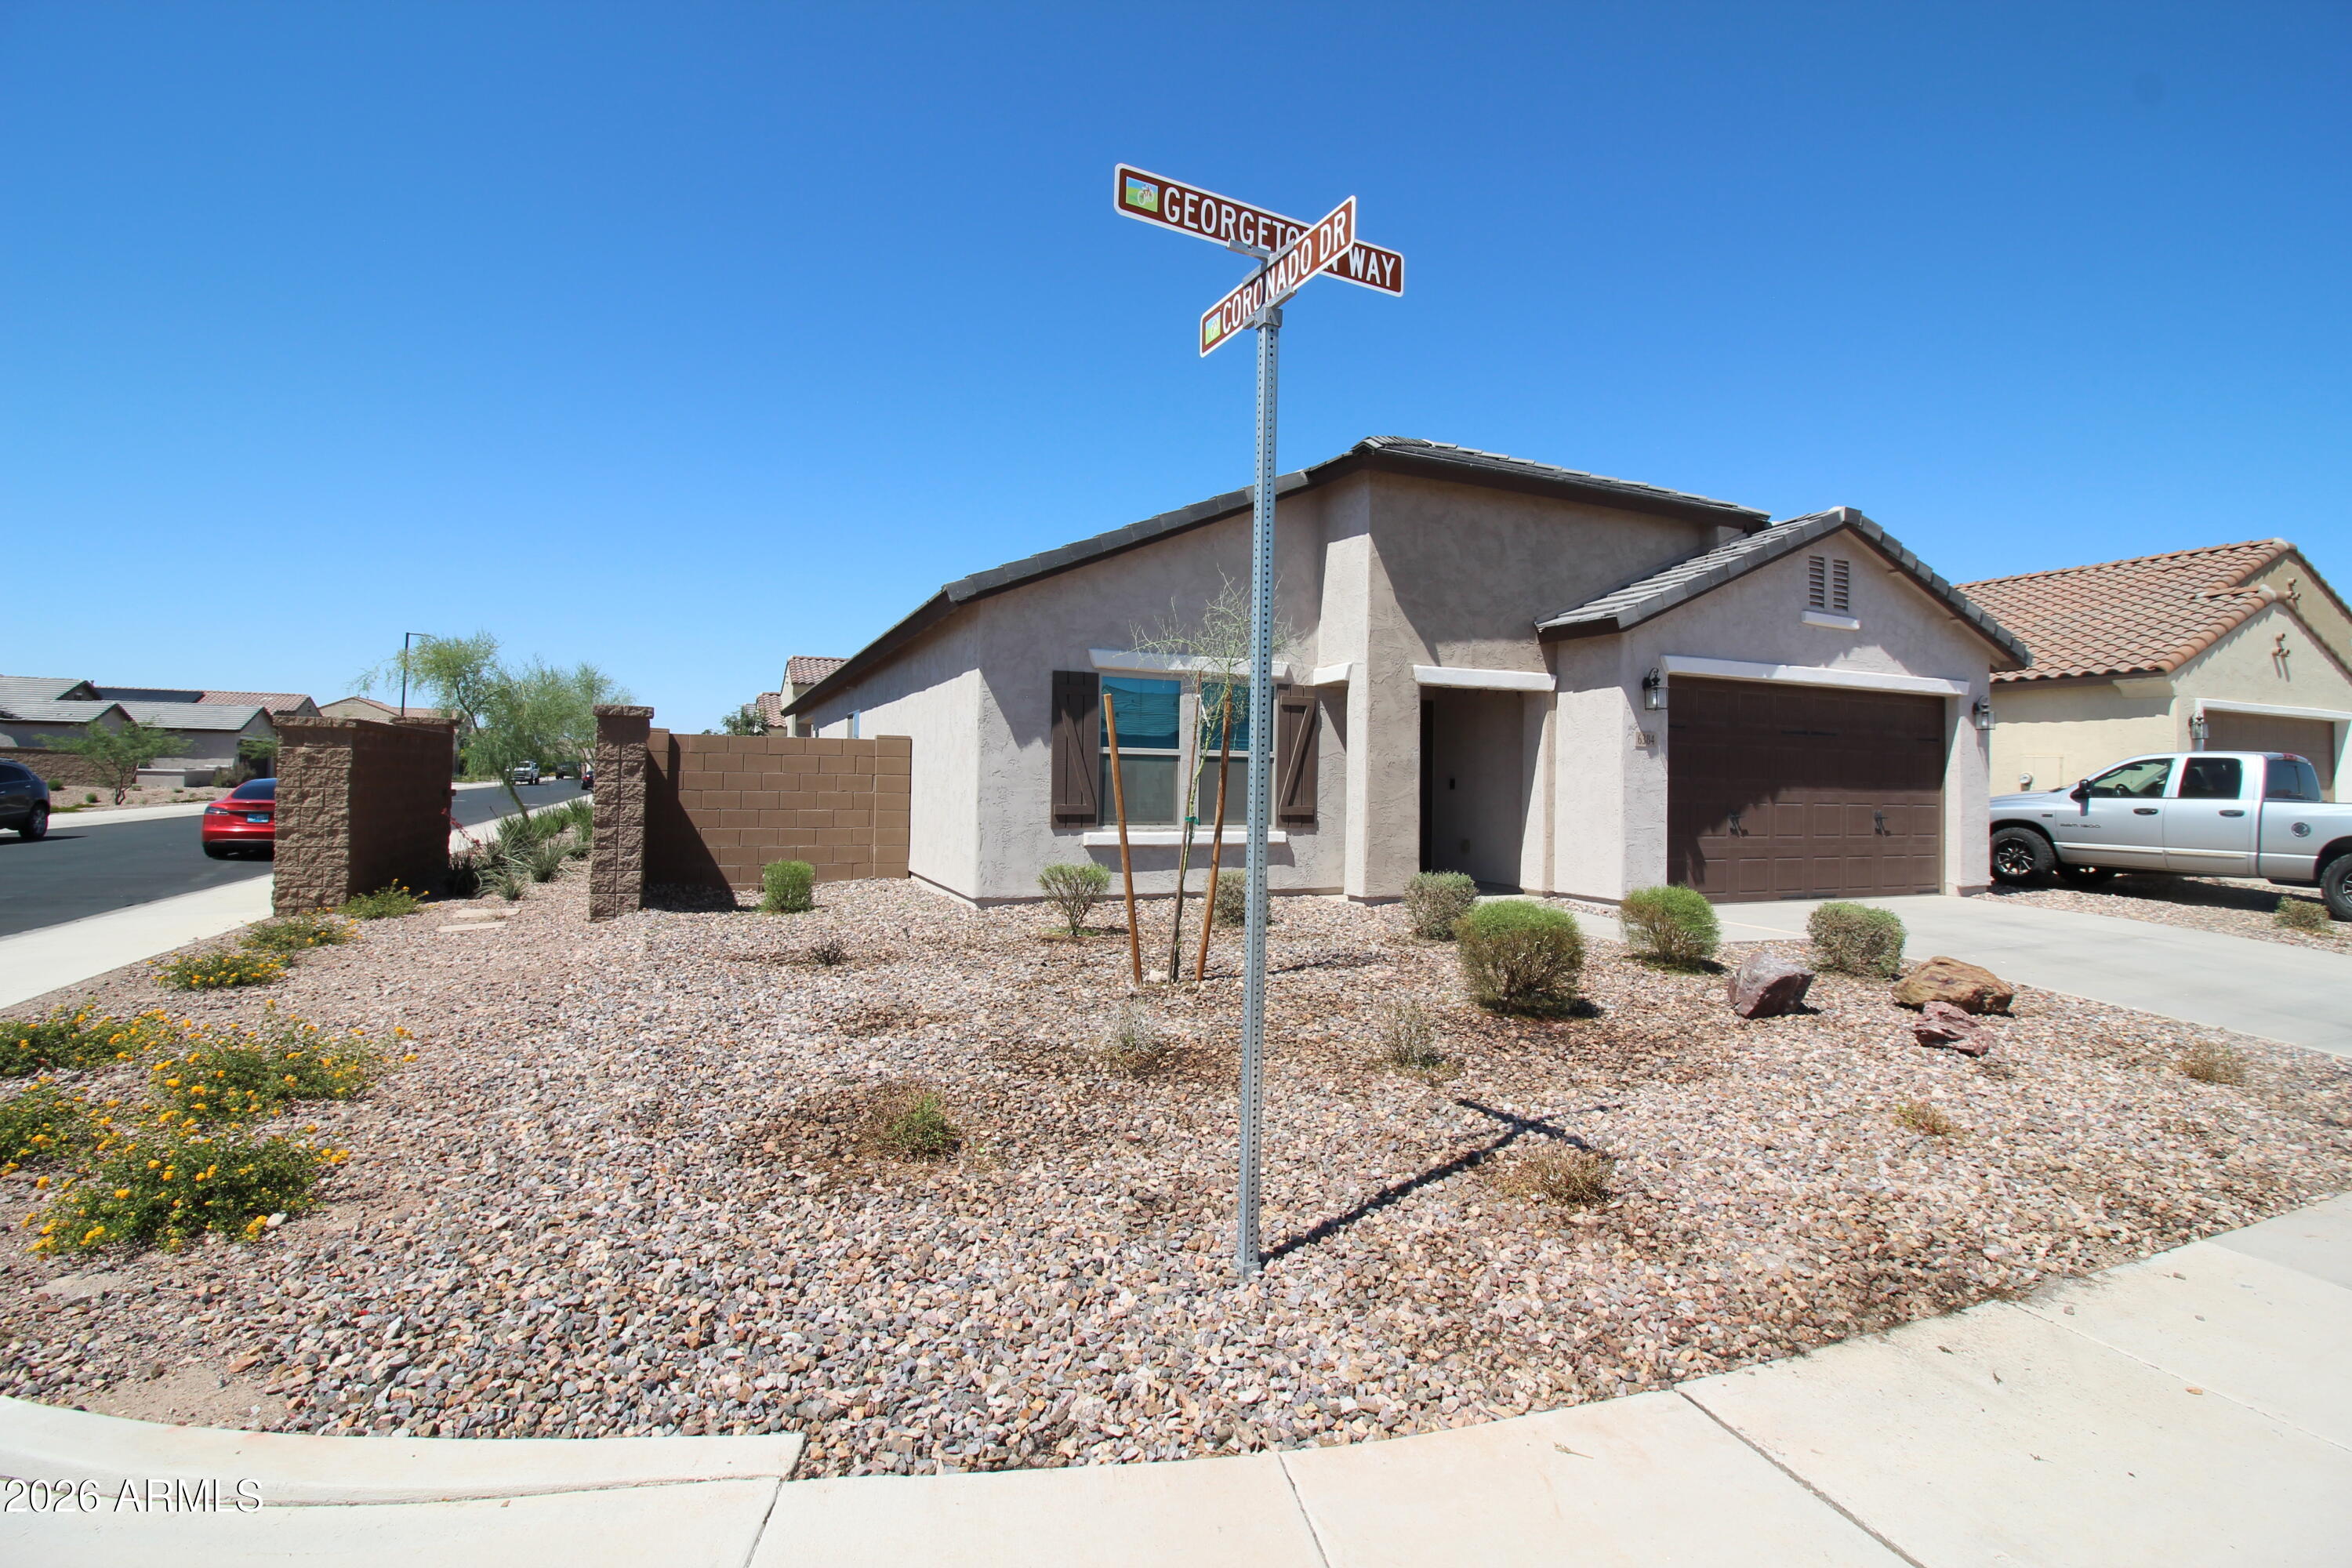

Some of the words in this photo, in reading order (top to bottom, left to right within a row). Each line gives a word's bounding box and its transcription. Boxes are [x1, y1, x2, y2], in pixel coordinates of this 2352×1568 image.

[1163, 186, 1339, 272] GEORGET
[1348, 246, 1396, 288] WAY
[1222, 238, 1312, 334] CORONADO
[1319, 210, 1347, 263] DR
[1638, 733, 1654, 746] 6384
